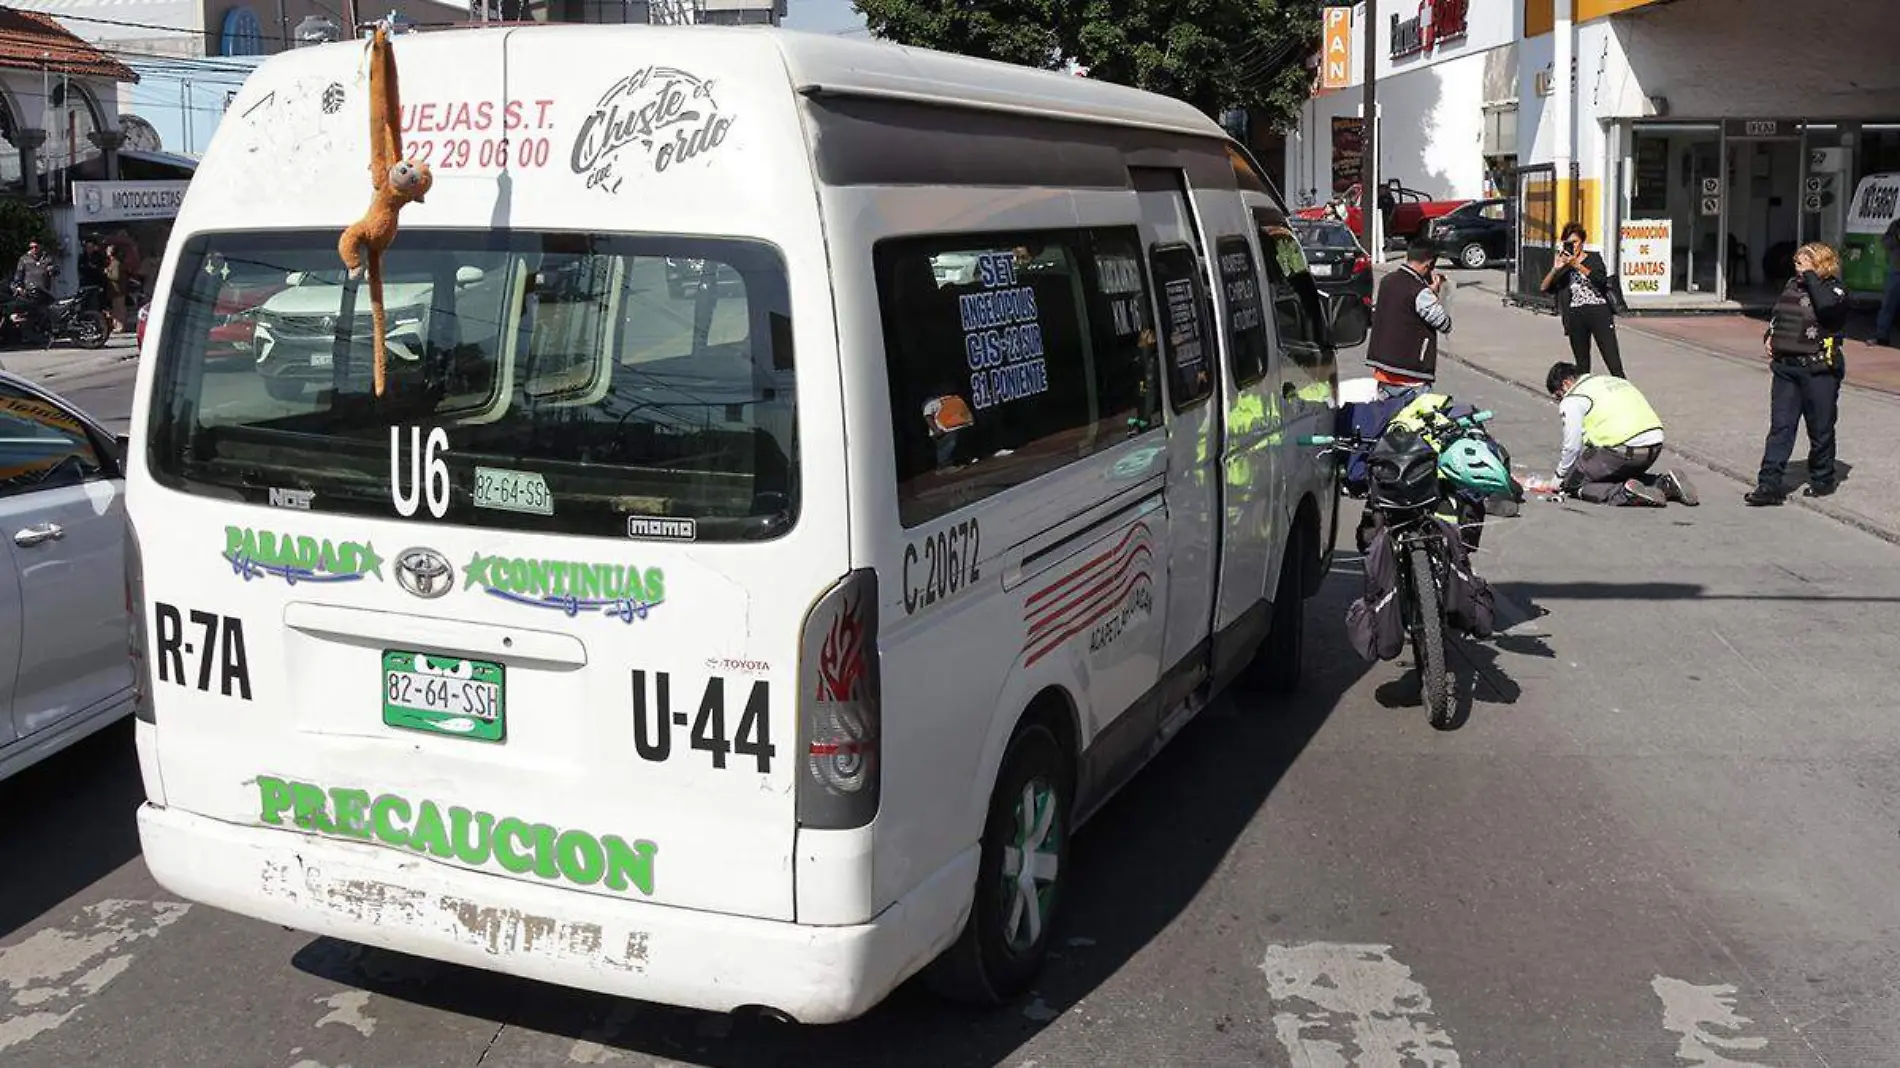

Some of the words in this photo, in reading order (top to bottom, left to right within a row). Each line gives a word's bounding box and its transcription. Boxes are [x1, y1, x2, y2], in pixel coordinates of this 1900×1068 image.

[1330, 9, 1345, 78] PAN
[400, 102, 494, 134] UEJAS
[504, 100, 555, 130] S.T.
[440, 138, 471, 168] 29
[479, 137, 509, 168] 06
[519, 137, 550, 168] 00
[641, 113, 737, 172] ordo
[112, 190, 181, 209] MOTOCICLETAS
[979, 252, 1017, 287] SET
[1623, 262, 1665, 276] LLANTAS
[1640, 244, 1650, 255] DE
[1629, 280, 1659, 292] CHINAS
[959, 288, 1038, 331] ANGELOPOLIS
[990, 359, 1048, 405] PONIENTE
[391, 426, 450, 518] U6
[225, 525, 365, 574] PARADAS
[631, 520, 692, 537] momo
[490, 555, 665, 603] CONTINUAS
[903, 518, 980, 615] C.20672
[155, 601, 252, 701] R-7A
[723, 659, 770, 671] TOYOTA
[388, 673, 499, 717] 82-64-SSH
[632, 669, 776, 774] U-44
[256, 775, 659, 896] PRECAUCION
